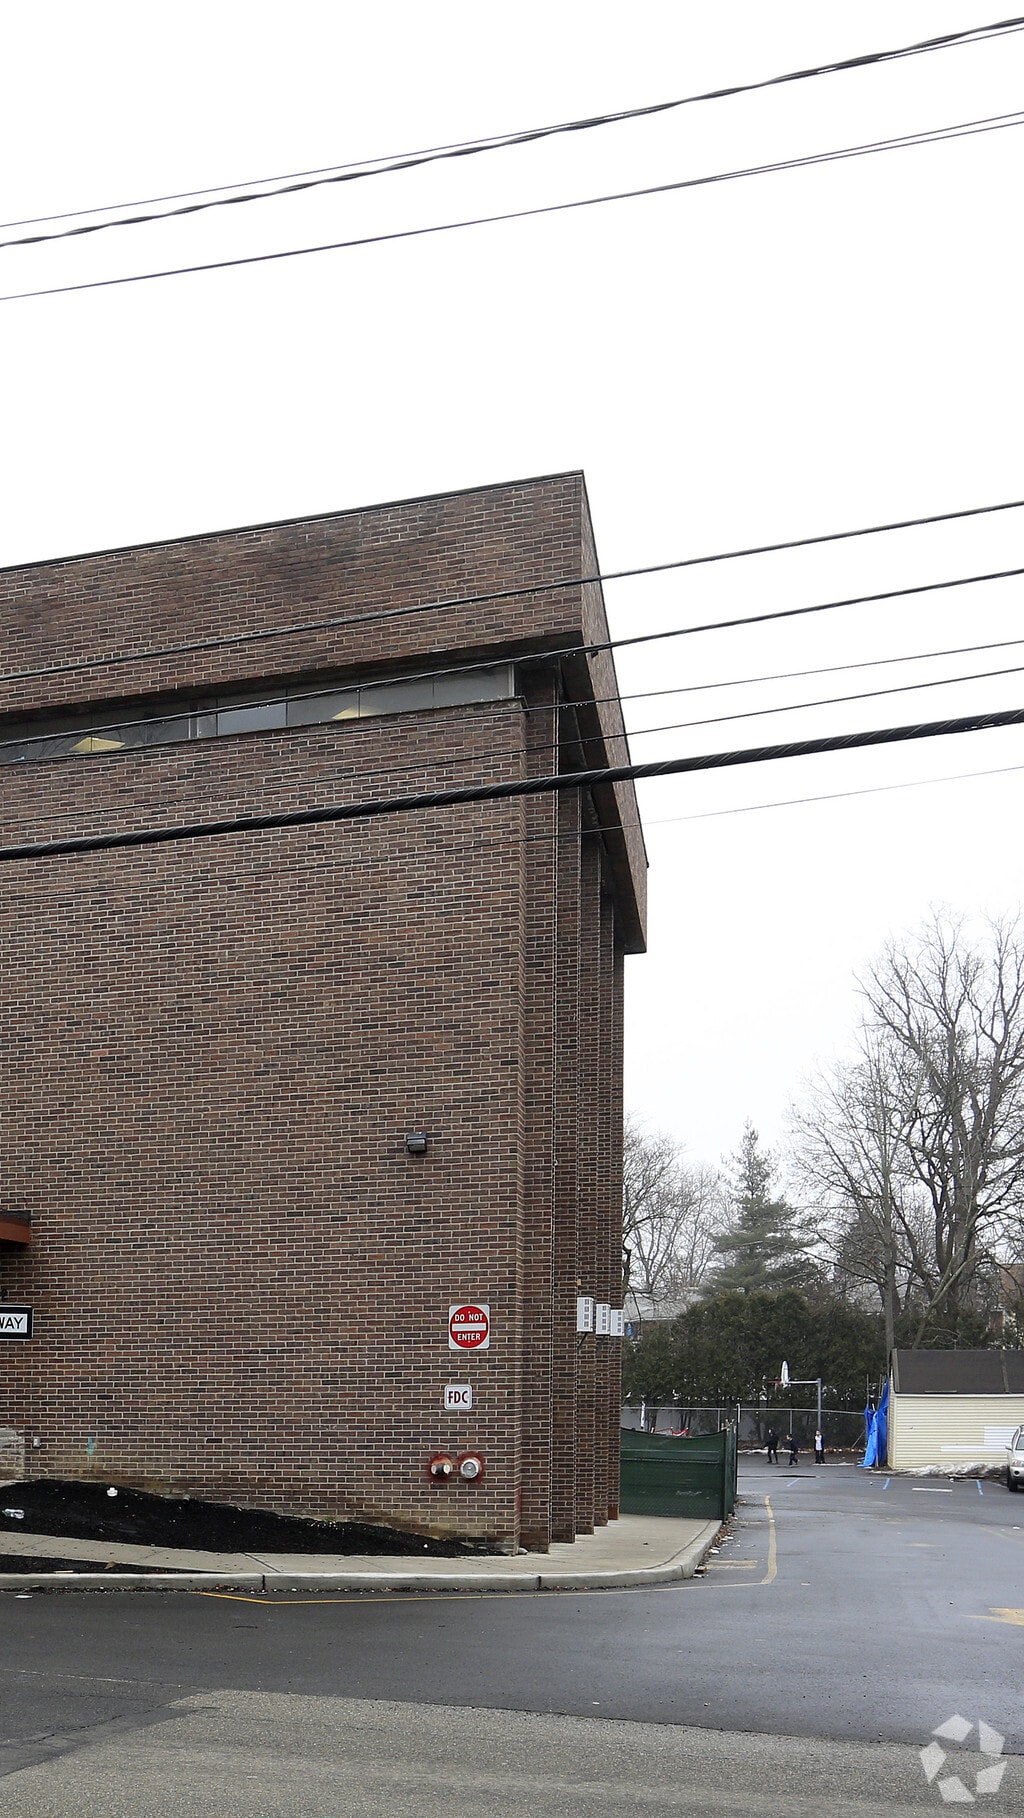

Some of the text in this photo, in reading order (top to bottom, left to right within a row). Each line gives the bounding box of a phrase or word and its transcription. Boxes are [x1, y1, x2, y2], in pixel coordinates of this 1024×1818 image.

[455, 1313, 483, 1322] DO NOT
[457, 1333, 481, 1341] ENTER
[448, 1391, 468, 1403] FDC
